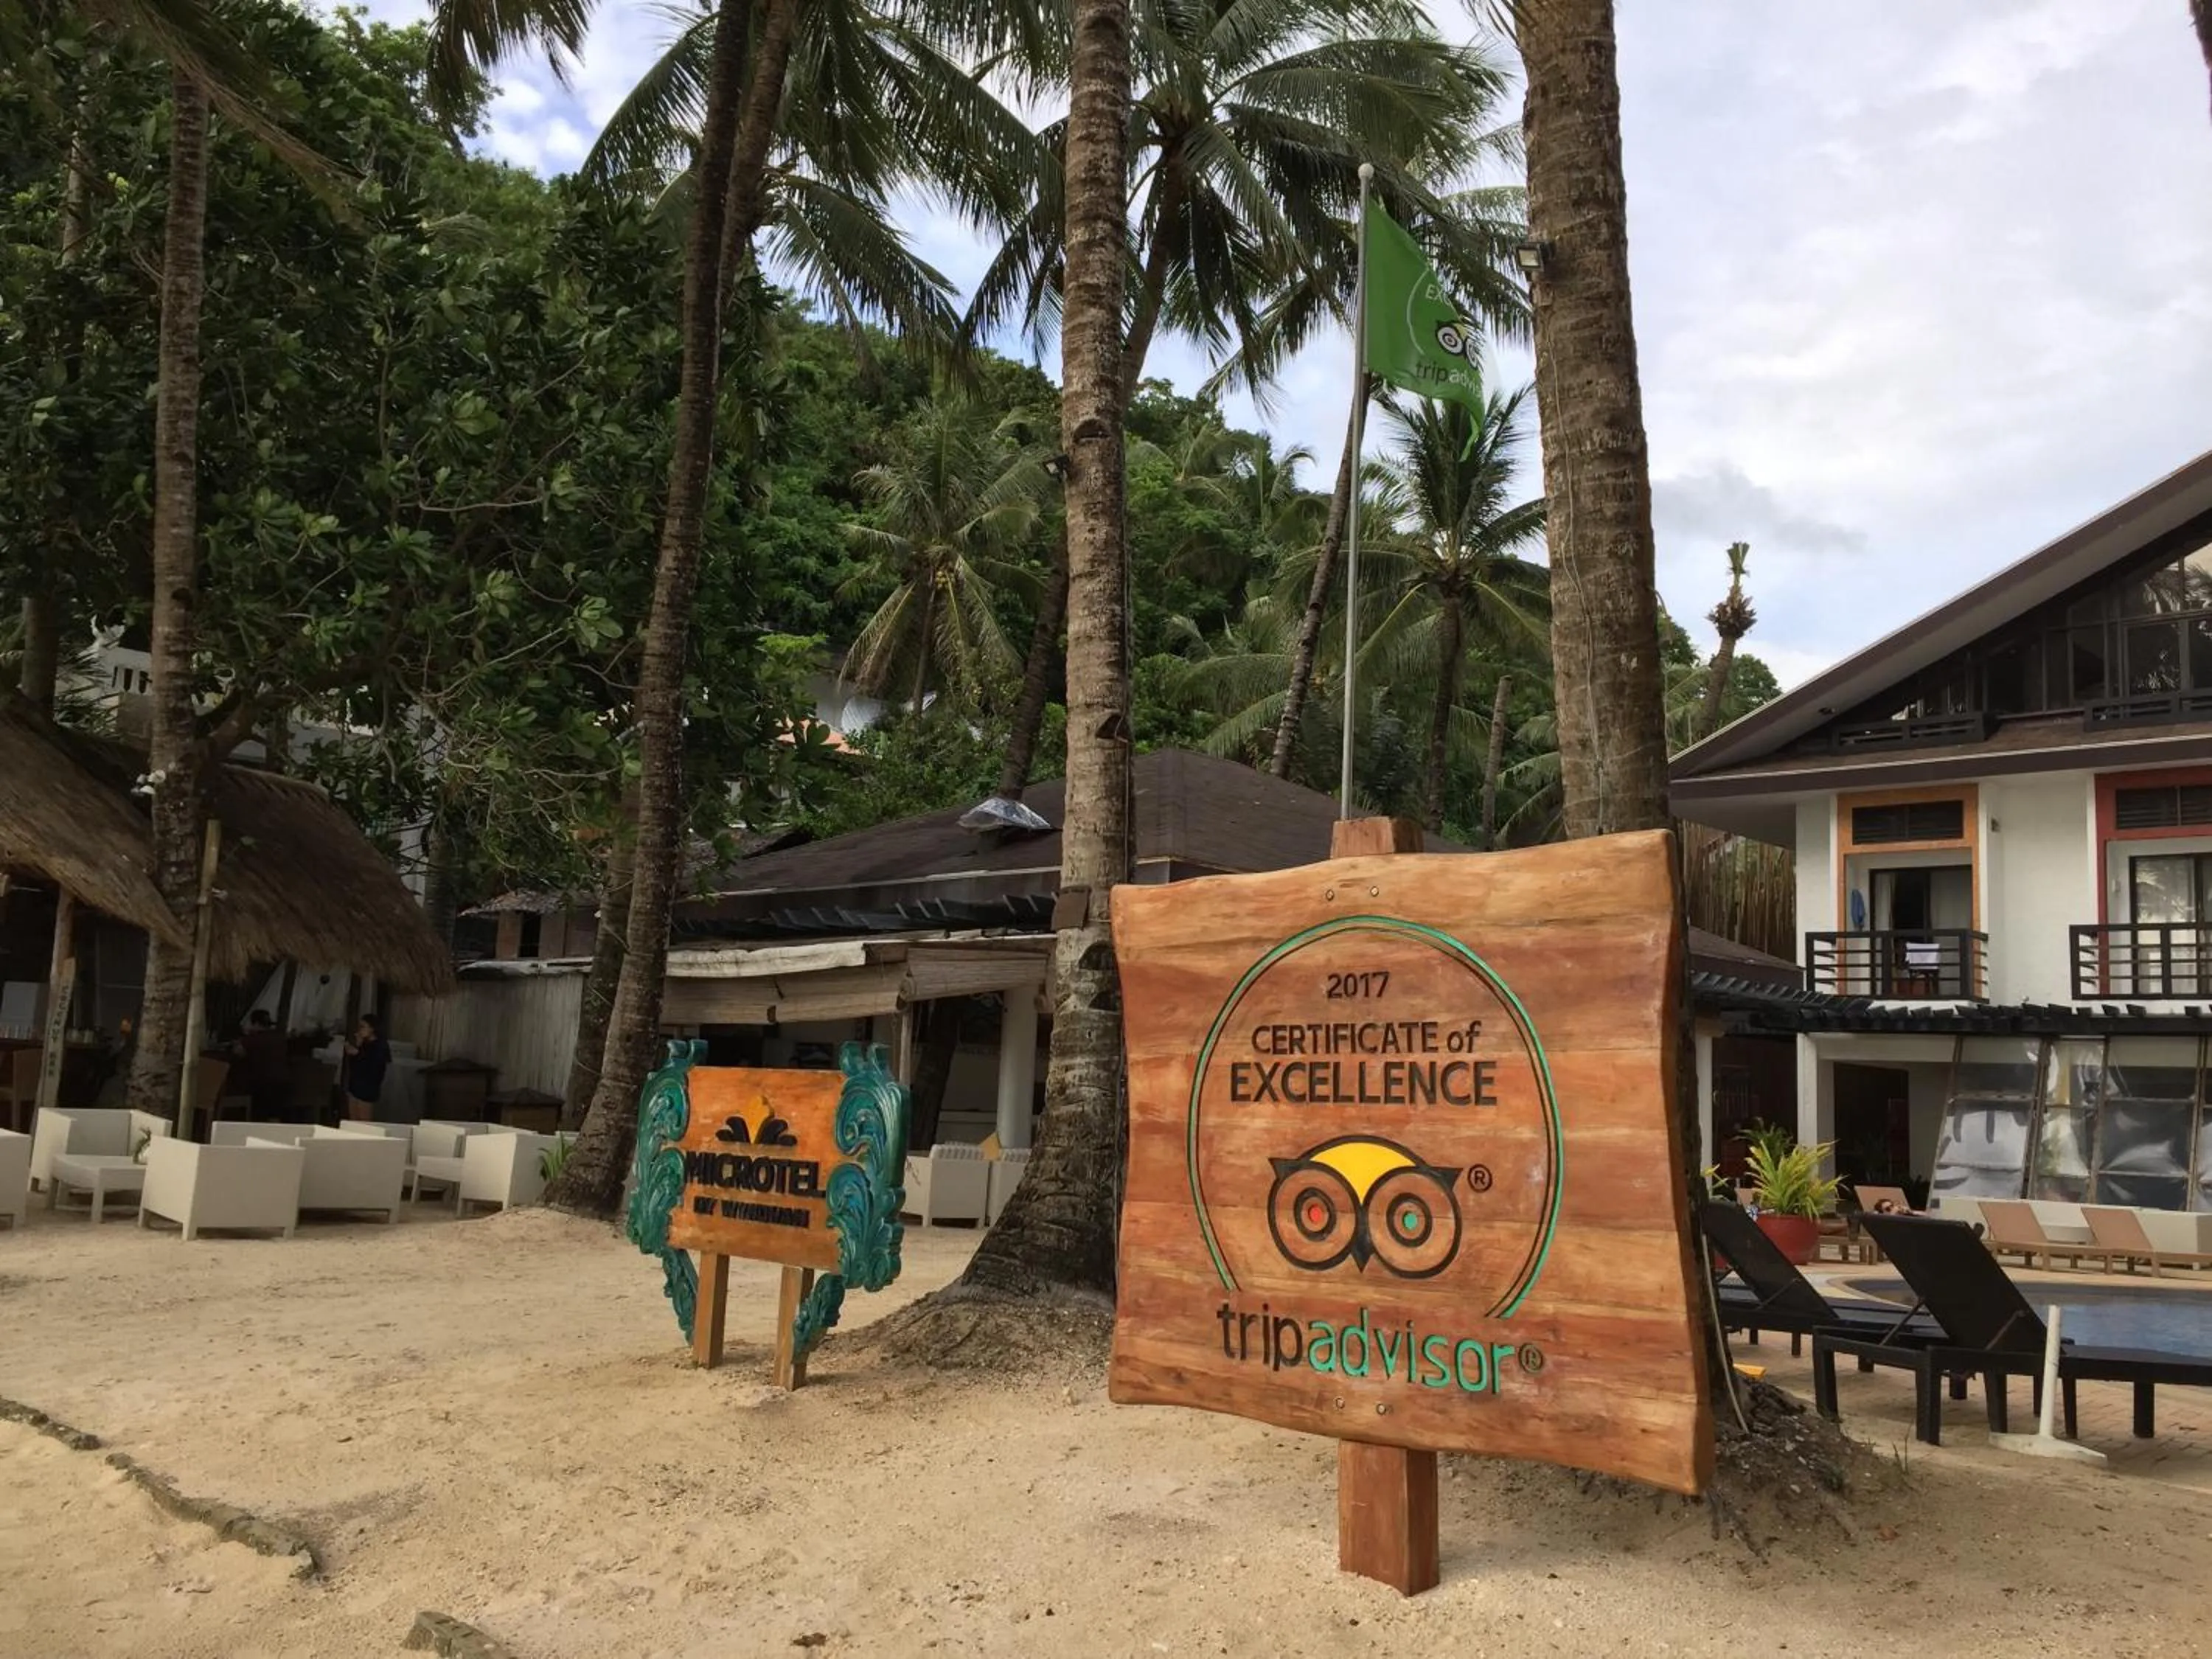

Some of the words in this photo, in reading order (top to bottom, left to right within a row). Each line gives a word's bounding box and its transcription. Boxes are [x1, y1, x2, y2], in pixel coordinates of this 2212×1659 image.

[1326, 971, 1390, 999] 2017
[1251, 1021, 1439, 1055] CERTIFICATE
[1446, 1020, 1483, 1054] of
[1230, 1060, 1498, 1106] EXCELLENCE
[684, 1150, 827, 1199] MICROTEL
[1217, 1302, 1516, 1394] tripadvisor
